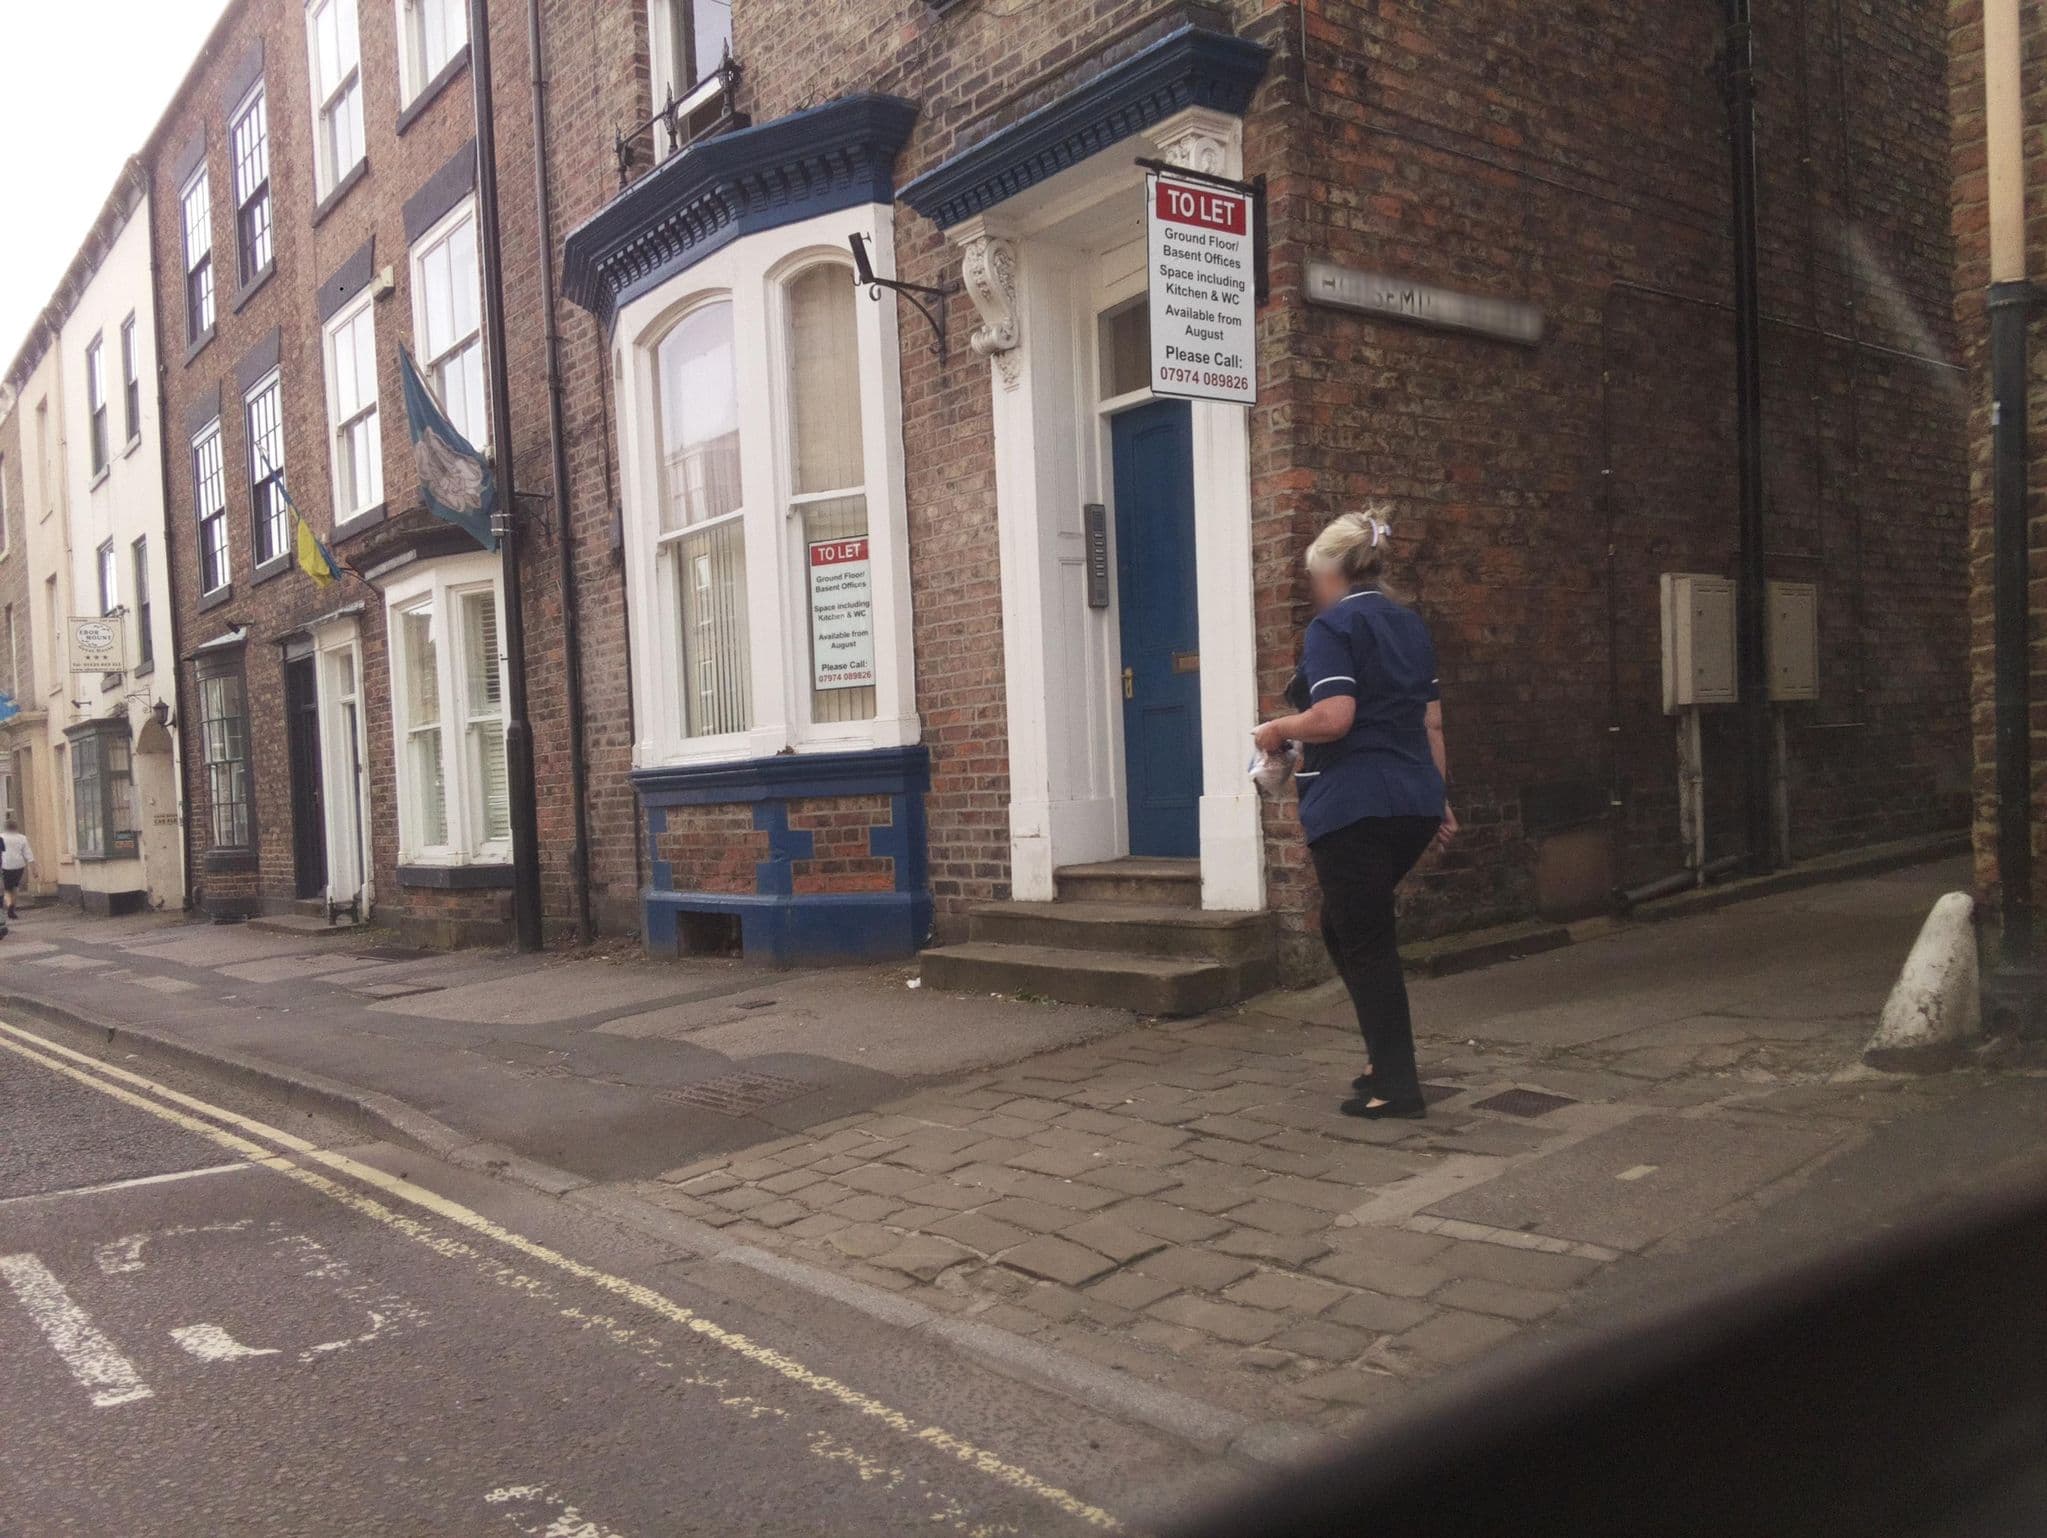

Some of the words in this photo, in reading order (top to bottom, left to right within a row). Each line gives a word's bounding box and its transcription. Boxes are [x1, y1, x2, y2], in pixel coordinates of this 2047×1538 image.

[1168, 189, 1195, 218] TO
[1199, 195, 1236, 226] LET
[1164, 227, 1206, 246] Ground
[1163, 244, 1202, 264] Basent
[1204, 251, 1242, 269] Offices
[1159, 264, 1194, 285] Space
[1196, 270, 1246, 292] including
[1165, 282, 1208, 301] Kitchen
[1210, 289, 1219, 302] &
[1221, 291, 1241, 305] WC
[1165, 304, 1215, 323] Available
[1217, 313, 1242, 327] from
[1184, 324, 1224, 342] August
[1165, 345, 1210, 364] Please
[1213, 351, 1243, 369] Call:
[1160, 366, 1200, 385] 07974
[1203, 372, 1249, 391] 089826
[818, 546, 835, 562] TO
[838, 542, 862, 559] LET
[815, 583, 840, 594] Basent
[842, 581, 867, 590] Offices
[814, 604, 836, 614] Space
[837, 599, 871, 611] including
[818, 612, 846, 622] Kitchen
[847, 611, 852, 619] &
[853, 609, 867, 618] WC
[818, 631, 850, 641] Available
[852, 629, 869, 638] from
[831, 640, 857, 650] August
[821, 662, 848, 672] Please
[849, 659, 868, 670] Call:
